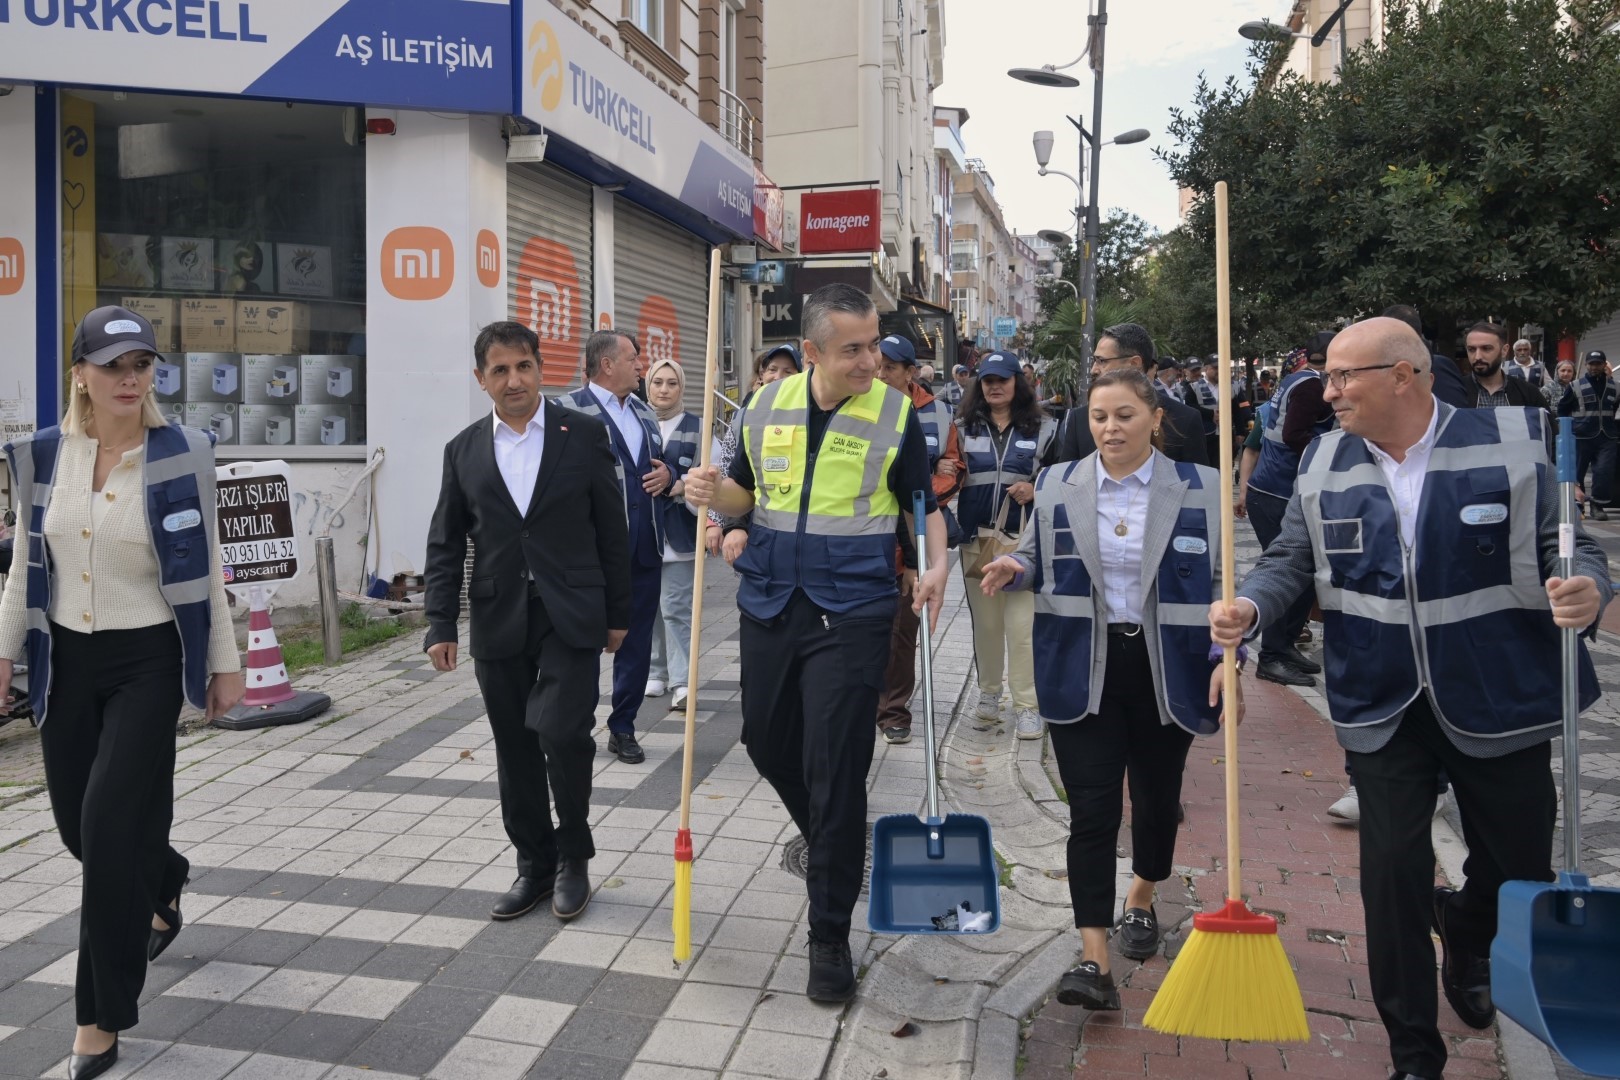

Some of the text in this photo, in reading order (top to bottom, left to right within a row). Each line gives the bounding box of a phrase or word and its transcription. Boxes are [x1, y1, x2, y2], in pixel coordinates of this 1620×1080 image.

[335, 30, 493, 72] AŞ İLETİŞİM
[568, 61, 656, 155] TURKCELL
[806, 213, 870, 234] komagene
[833, 437, 865, 450] CAN AKSOY
[222, 513, 276, 538] YAPILIR
[220, 540, 294, 564] 30 931 04 32
[236, 562, 289, 580] ayscarrff
